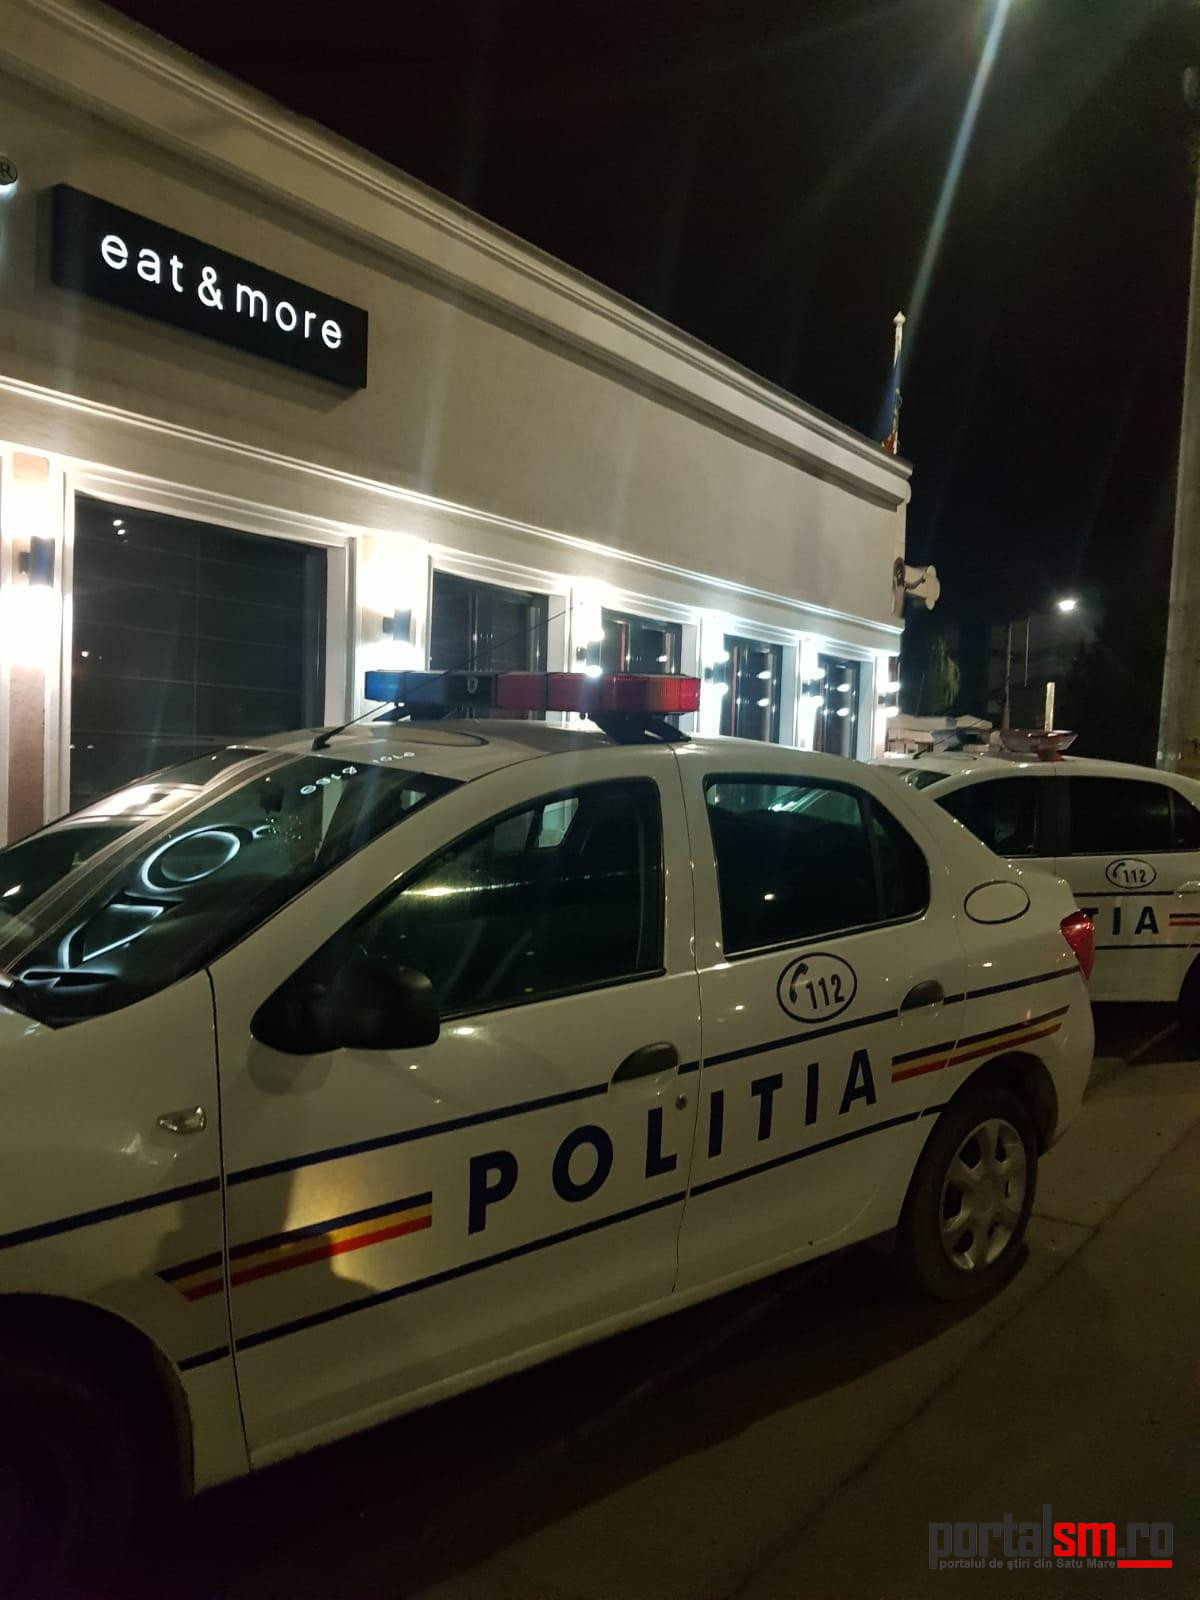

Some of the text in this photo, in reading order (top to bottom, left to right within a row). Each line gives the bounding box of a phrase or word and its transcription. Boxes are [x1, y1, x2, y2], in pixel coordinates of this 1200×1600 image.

[101, 234, 184, 292] eat
[236, 282, 342, 349] more
[1123, 869, 1146, 883] 112
[804, 973, 845, 1010] 112
[468, 1048, 877, 1235] POLITIA
